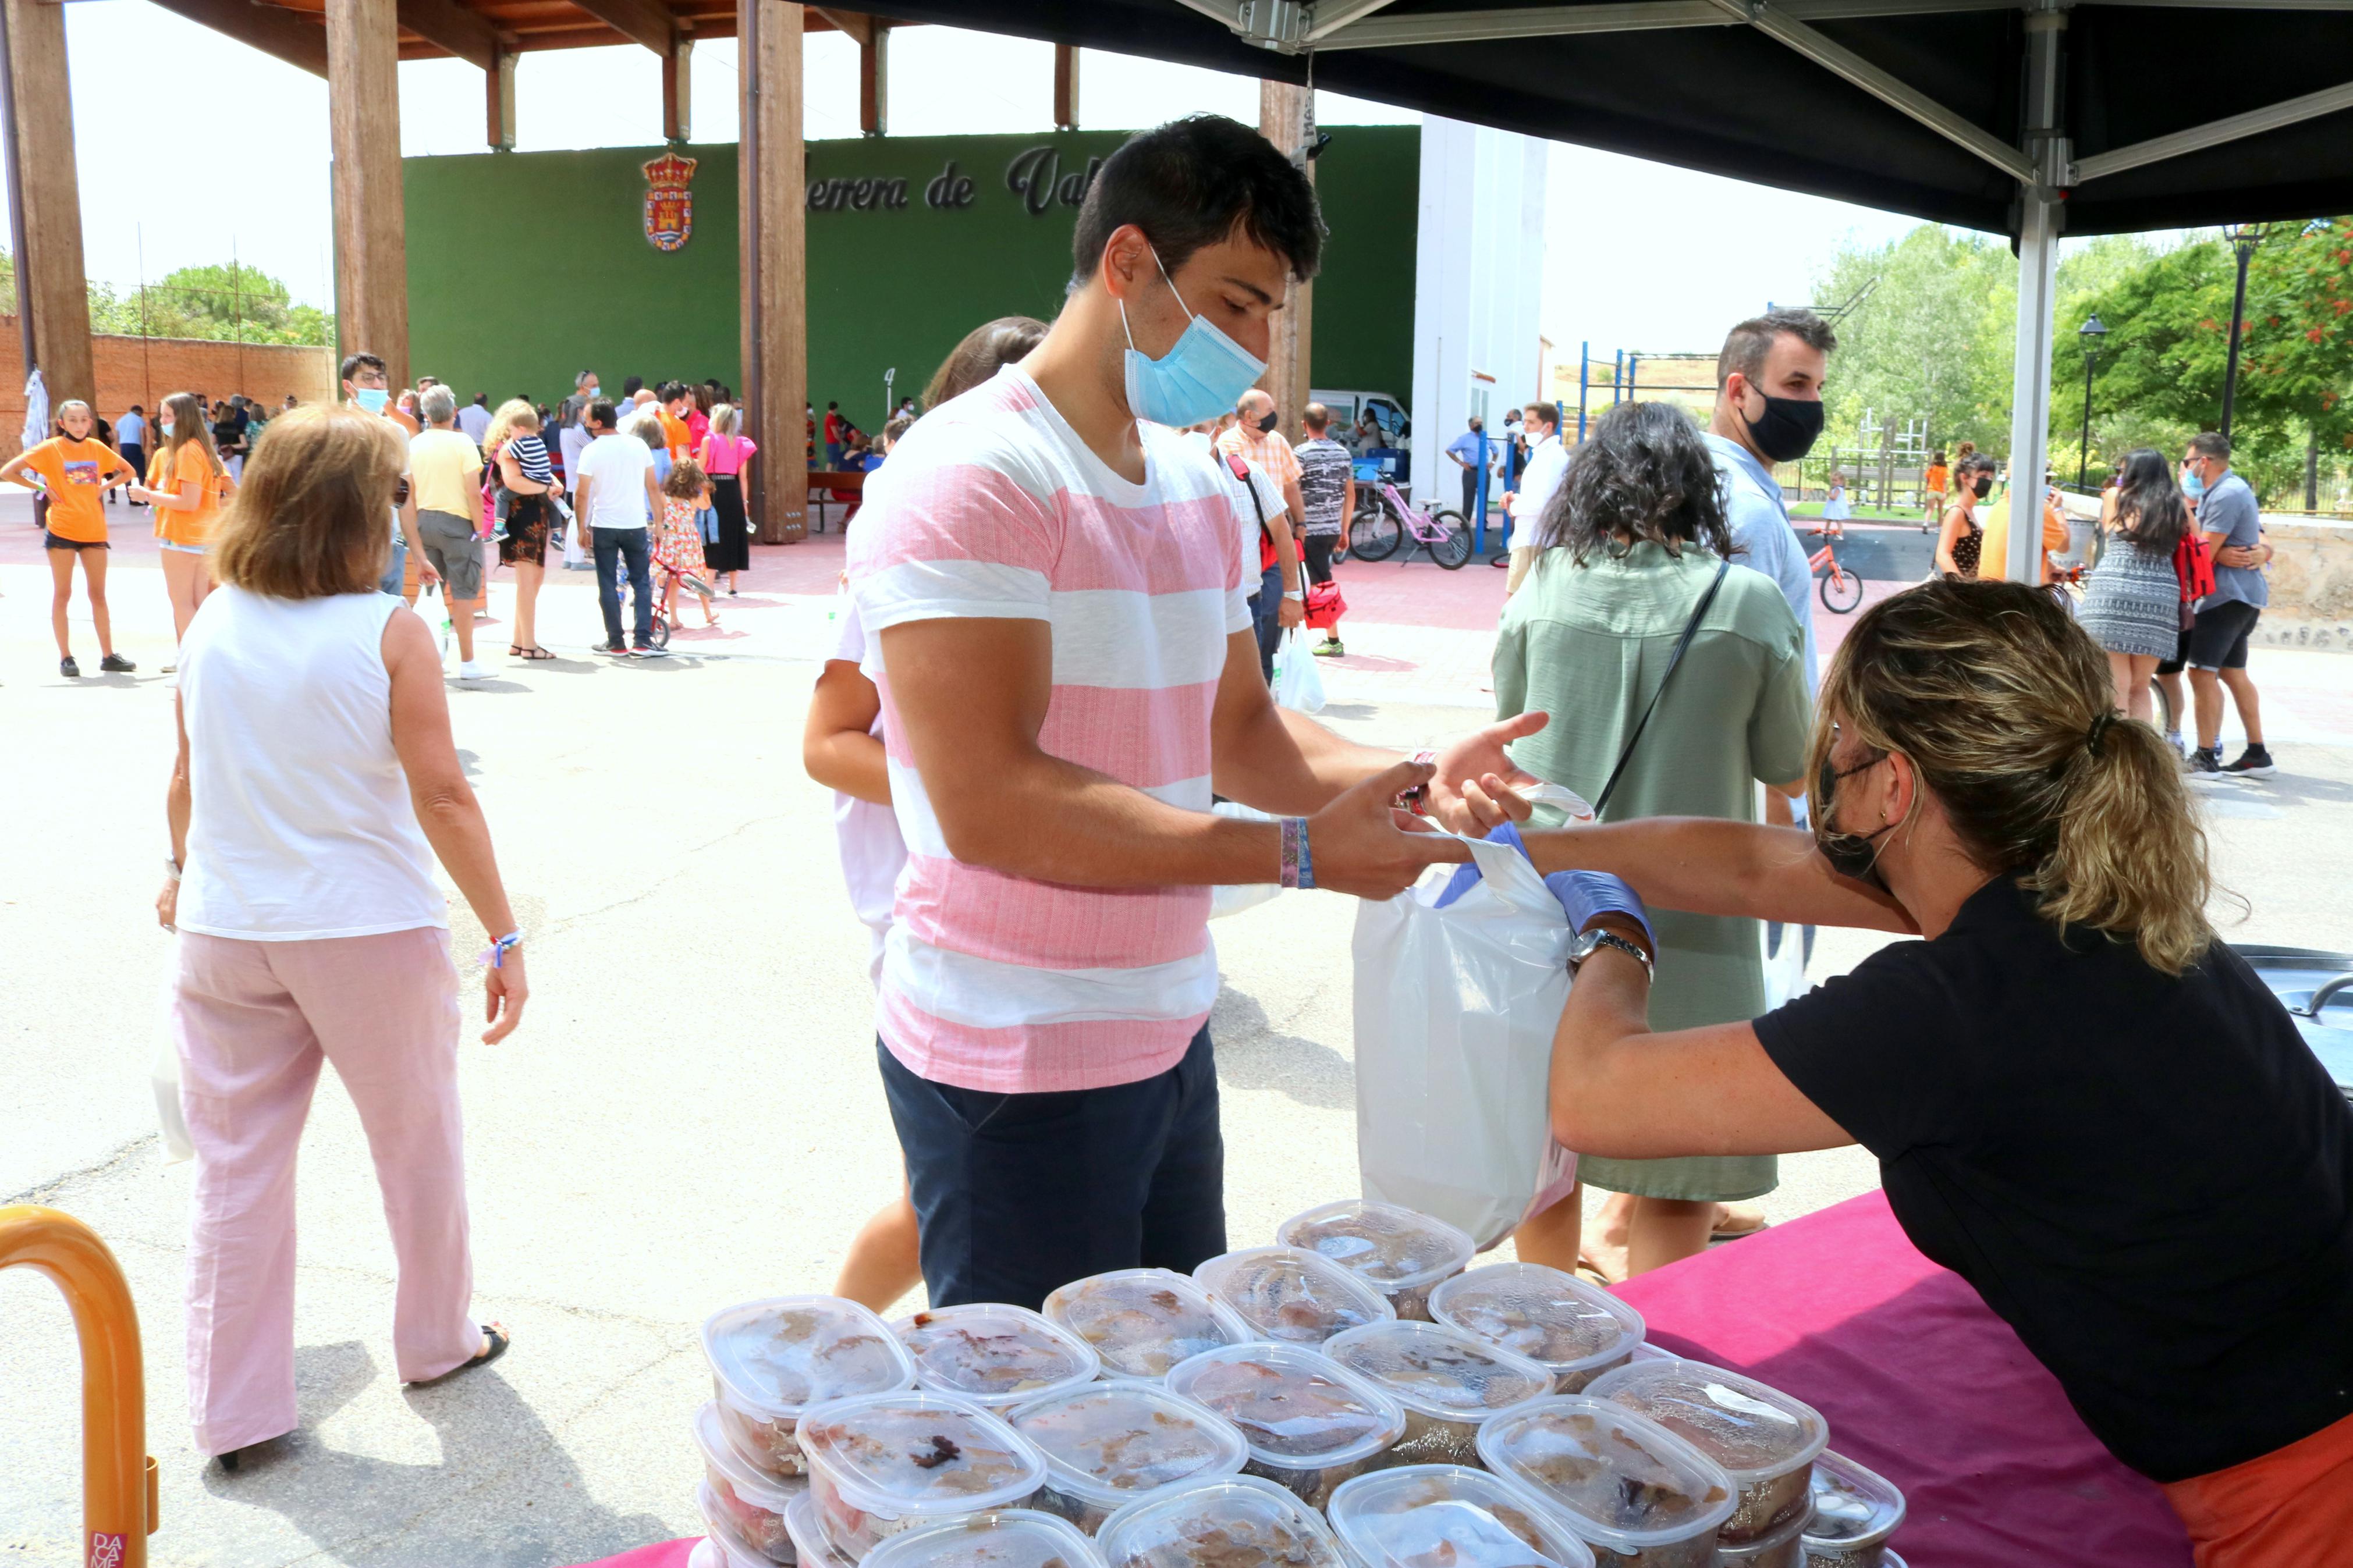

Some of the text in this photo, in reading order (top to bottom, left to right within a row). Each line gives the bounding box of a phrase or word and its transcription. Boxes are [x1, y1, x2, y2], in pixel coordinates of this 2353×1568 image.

[805, 151, 908, 211] errera
[925, 161, 974, 208] de
[94, 1533, 122, 1550] DA
[95, 1546, 119, 1561] CA
